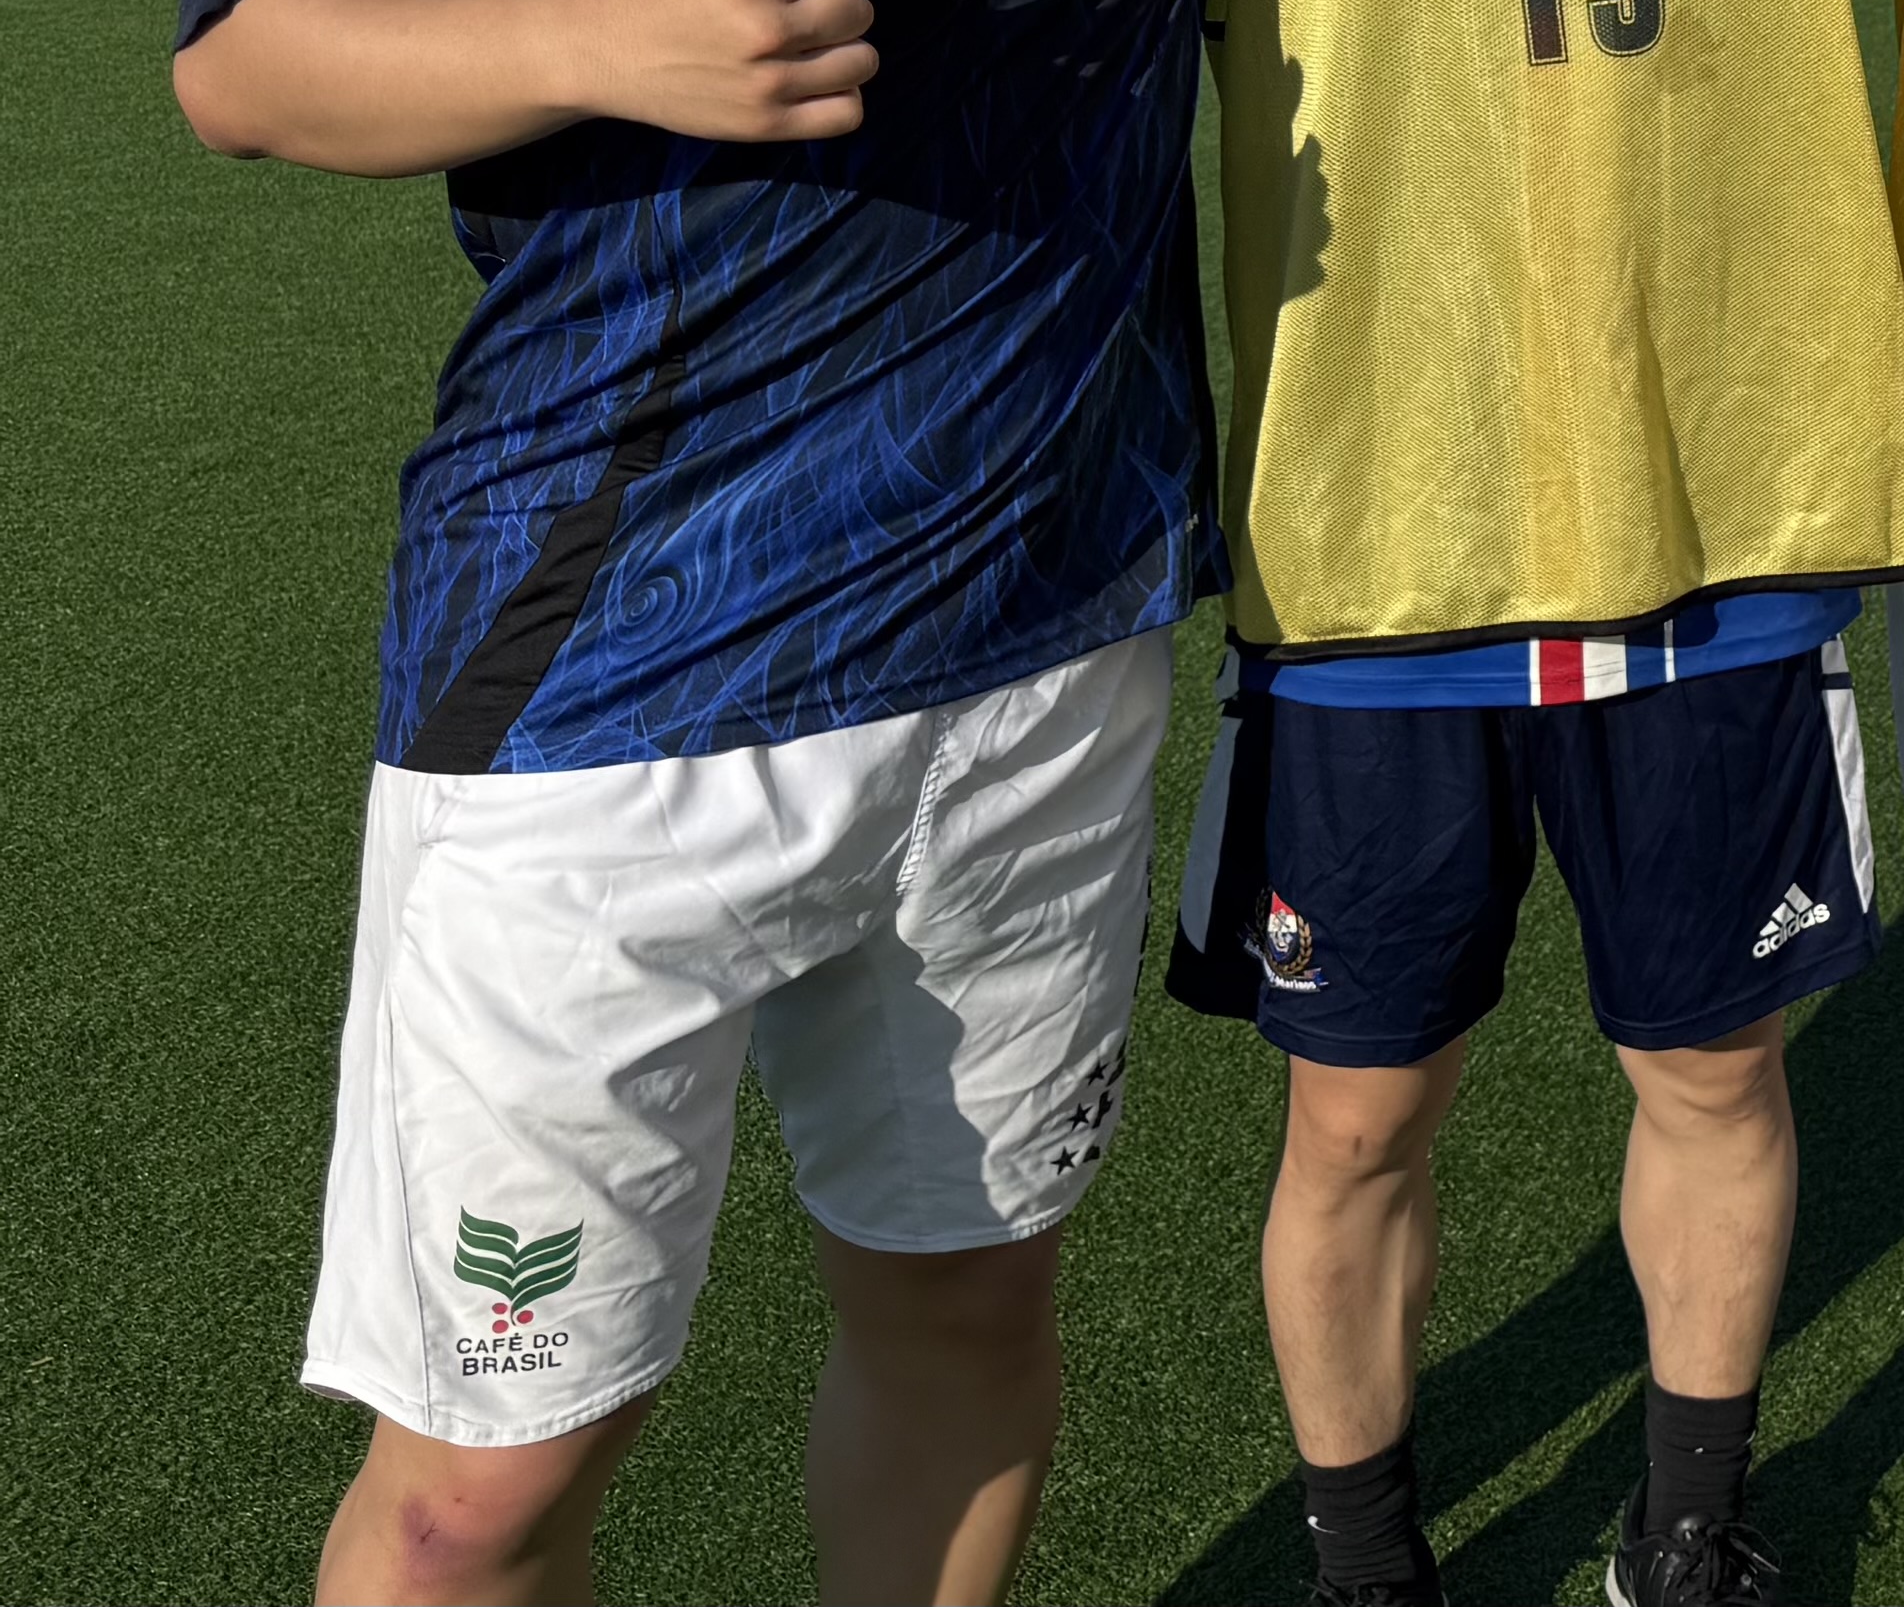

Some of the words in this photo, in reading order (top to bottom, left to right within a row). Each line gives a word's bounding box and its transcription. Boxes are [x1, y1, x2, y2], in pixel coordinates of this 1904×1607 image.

[1752, 903, 1831, 959] adidas
[456, 1332, 523, 1354] CAFÉ
[533, 1332, 569, 1348] DO
[462, 1351, 562, 1376] BRASIL
